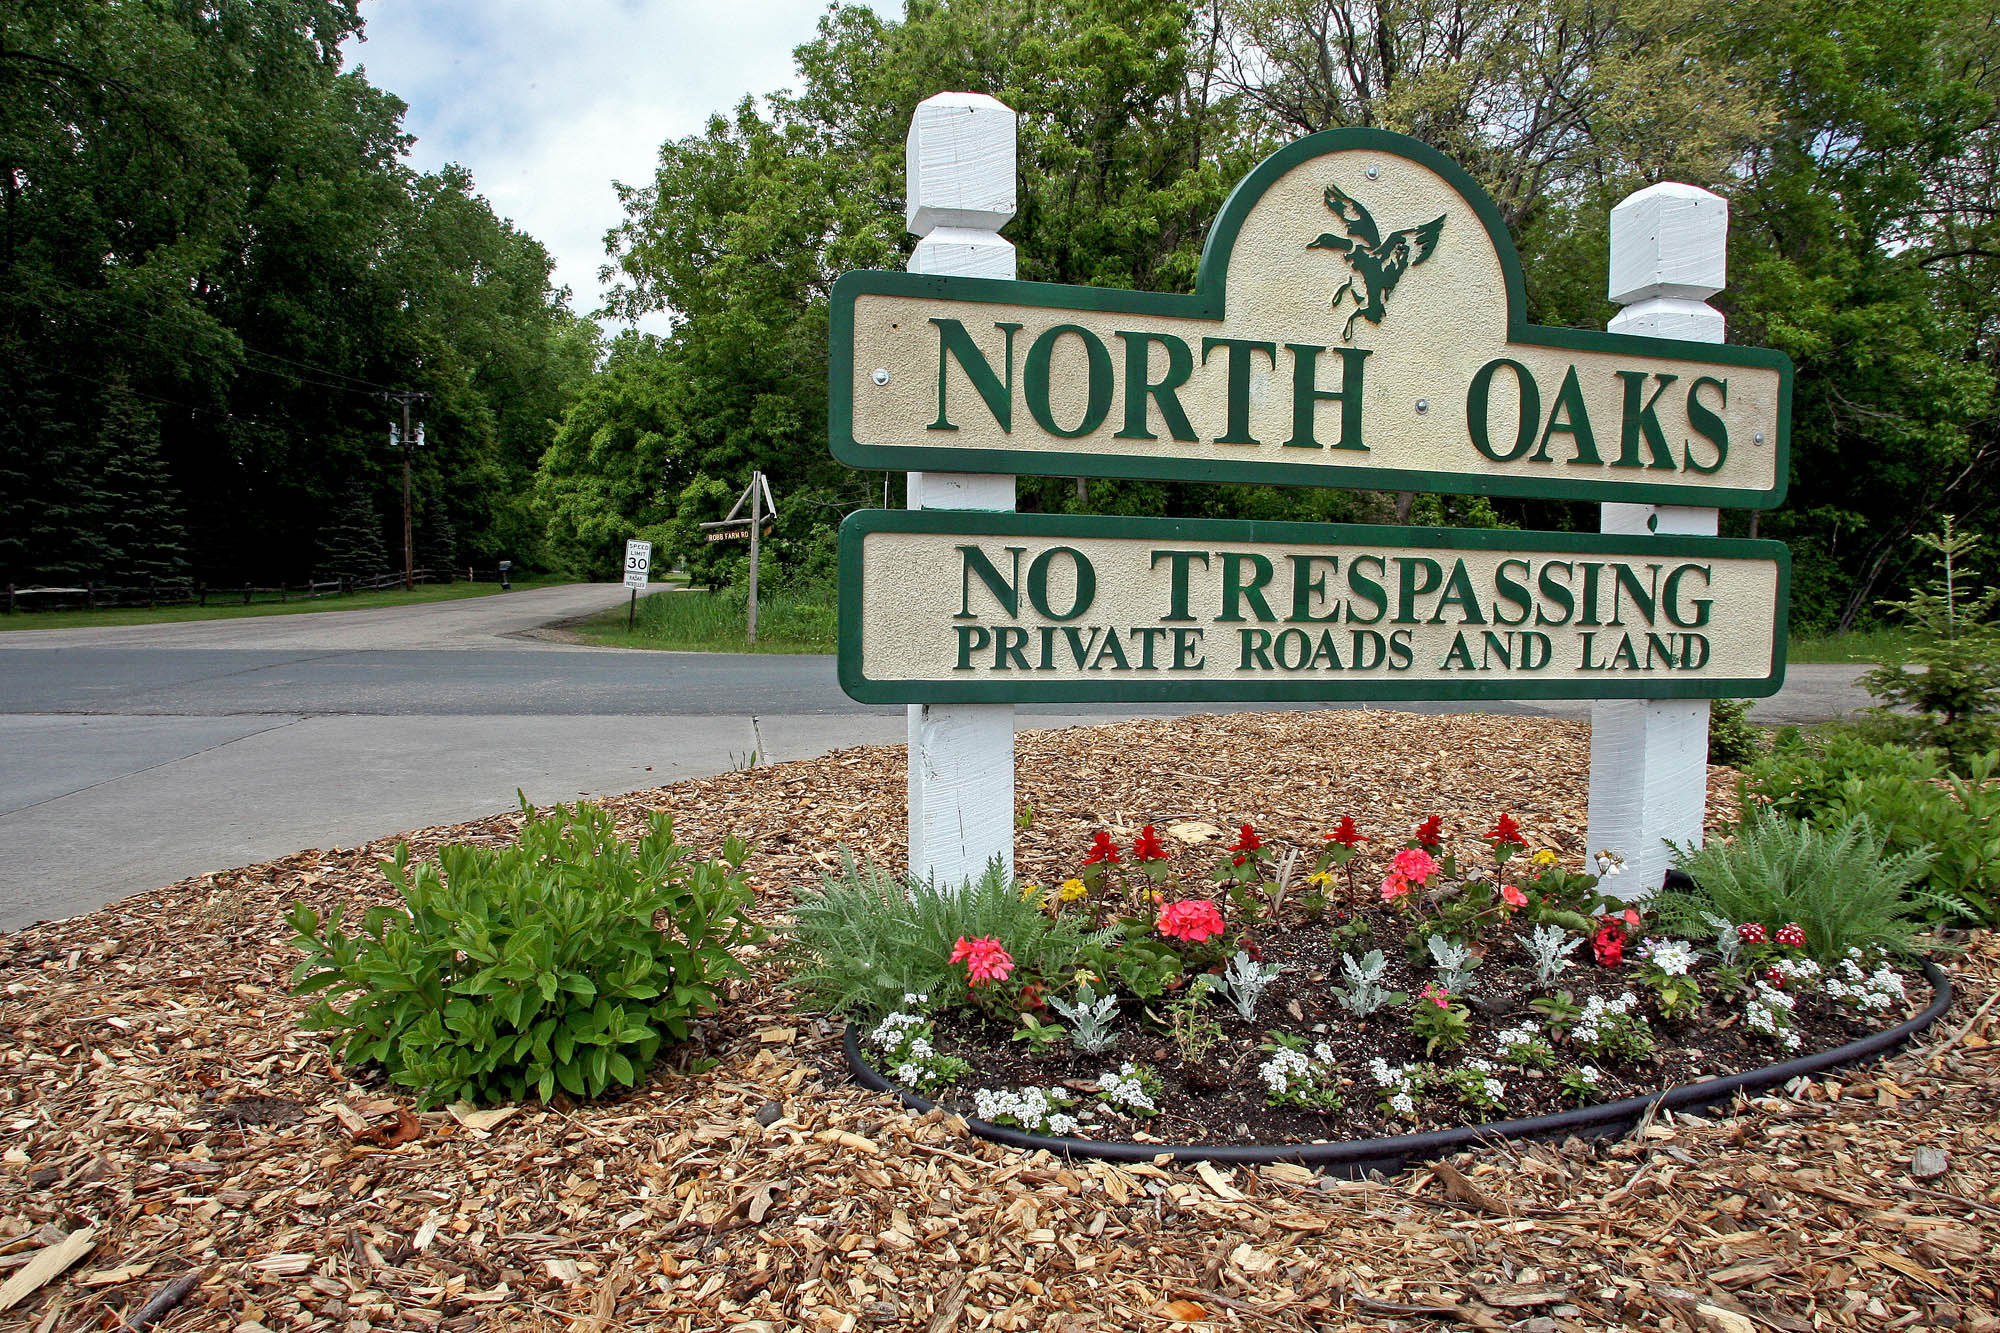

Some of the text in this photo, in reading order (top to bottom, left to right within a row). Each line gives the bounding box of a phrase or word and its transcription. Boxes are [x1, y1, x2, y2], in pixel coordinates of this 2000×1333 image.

[927, 317, 1729, 474] NORTH OAKS
[725, 532, 740, 540] FARM
[627, 557, 647, 570] 30
[953, 545, 1713, 628] NO TRESPASSING
[952, 625, 1711, 671] PRIVATE ROADS AND LAND
